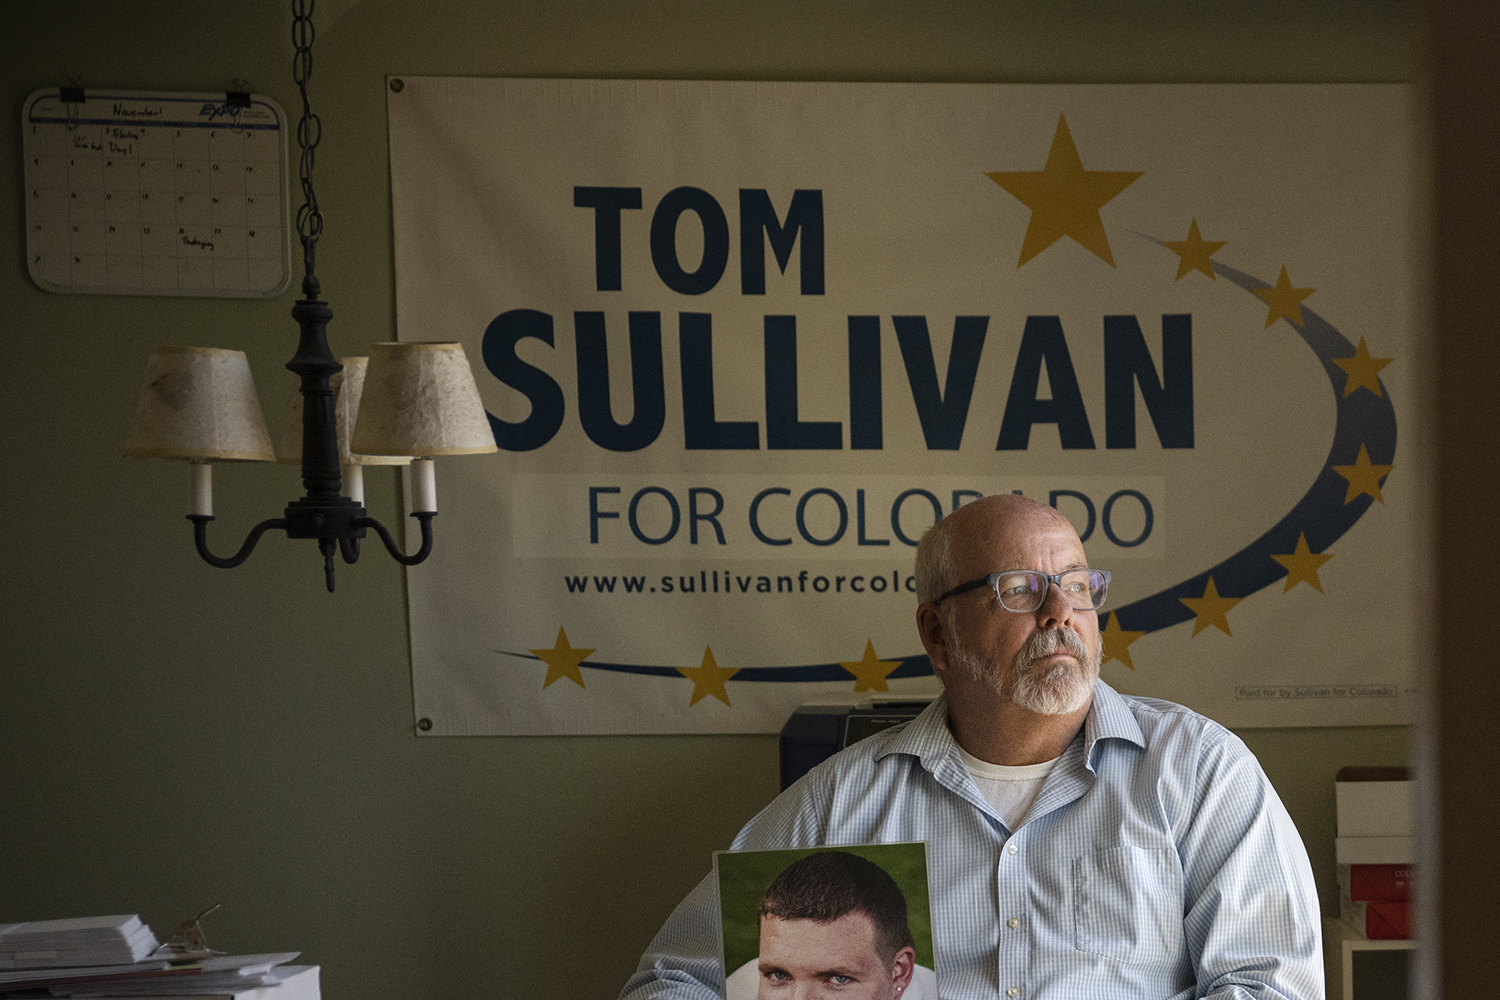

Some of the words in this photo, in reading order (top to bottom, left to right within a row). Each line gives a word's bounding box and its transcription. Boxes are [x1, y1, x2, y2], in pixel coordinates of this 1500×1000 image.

[573, 185, 826, 296] TOM
[481, 308, 1195, 453] SULLIVAN
[588, 485, 727, 546] FOR
[748, 487, 1154, 548] COLODO
[1239, 687, 1260, 697] Paid
[1263, 688, 1277, 697] for
[1279, 688, 1291, 699] by
[1295, 687, 1330, 697] Sullivan
[1333, 686, 1346, 696] for
